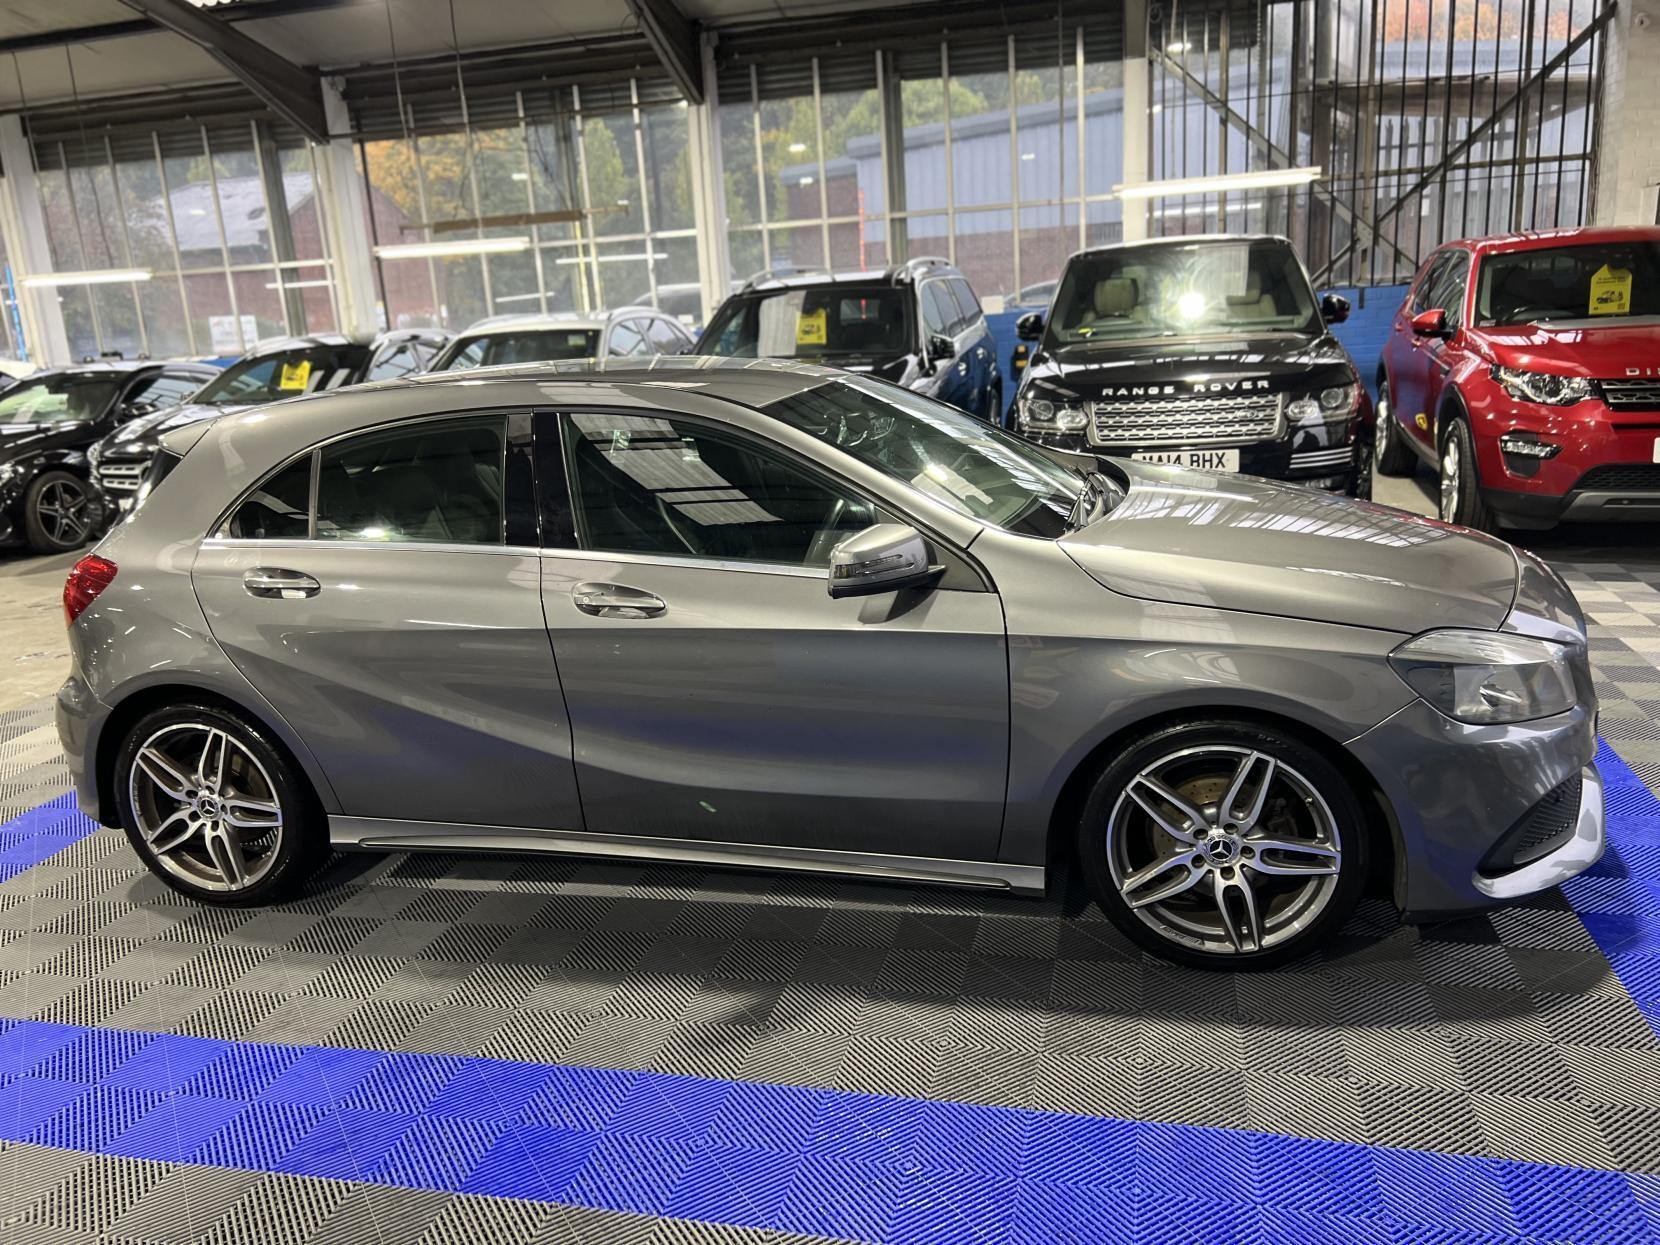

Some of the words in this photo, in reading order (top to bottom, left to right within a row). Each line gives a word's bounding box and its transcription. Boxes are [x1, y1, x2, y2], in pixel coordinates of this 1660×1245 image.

[1625, 367, 1660, 376] DI
[1102, 385, 1175, 396] RANGE
[1193, 380, 1270, 392] ROVER
